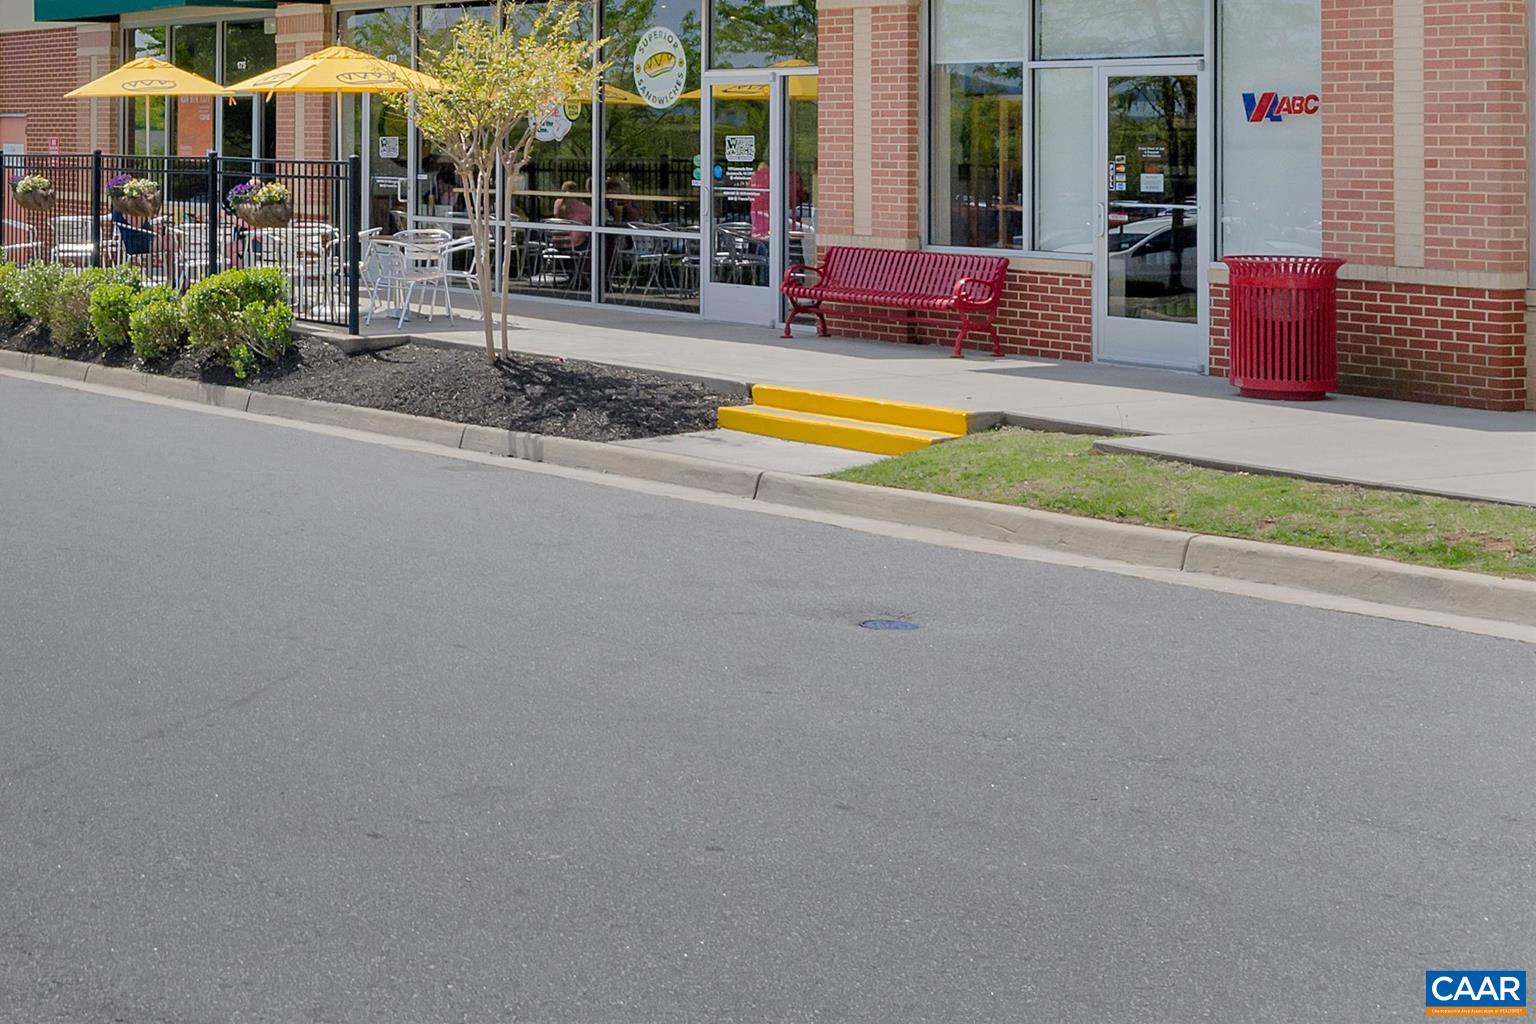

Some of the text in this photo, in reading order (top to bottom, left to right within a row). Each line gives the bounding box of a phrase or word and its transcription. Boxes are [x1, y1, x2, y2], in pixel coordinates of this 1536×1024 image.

[637, 30, 684, 105] SUPERIOR SANDWICHES
[1274, 94, 1320, 115] ABC
